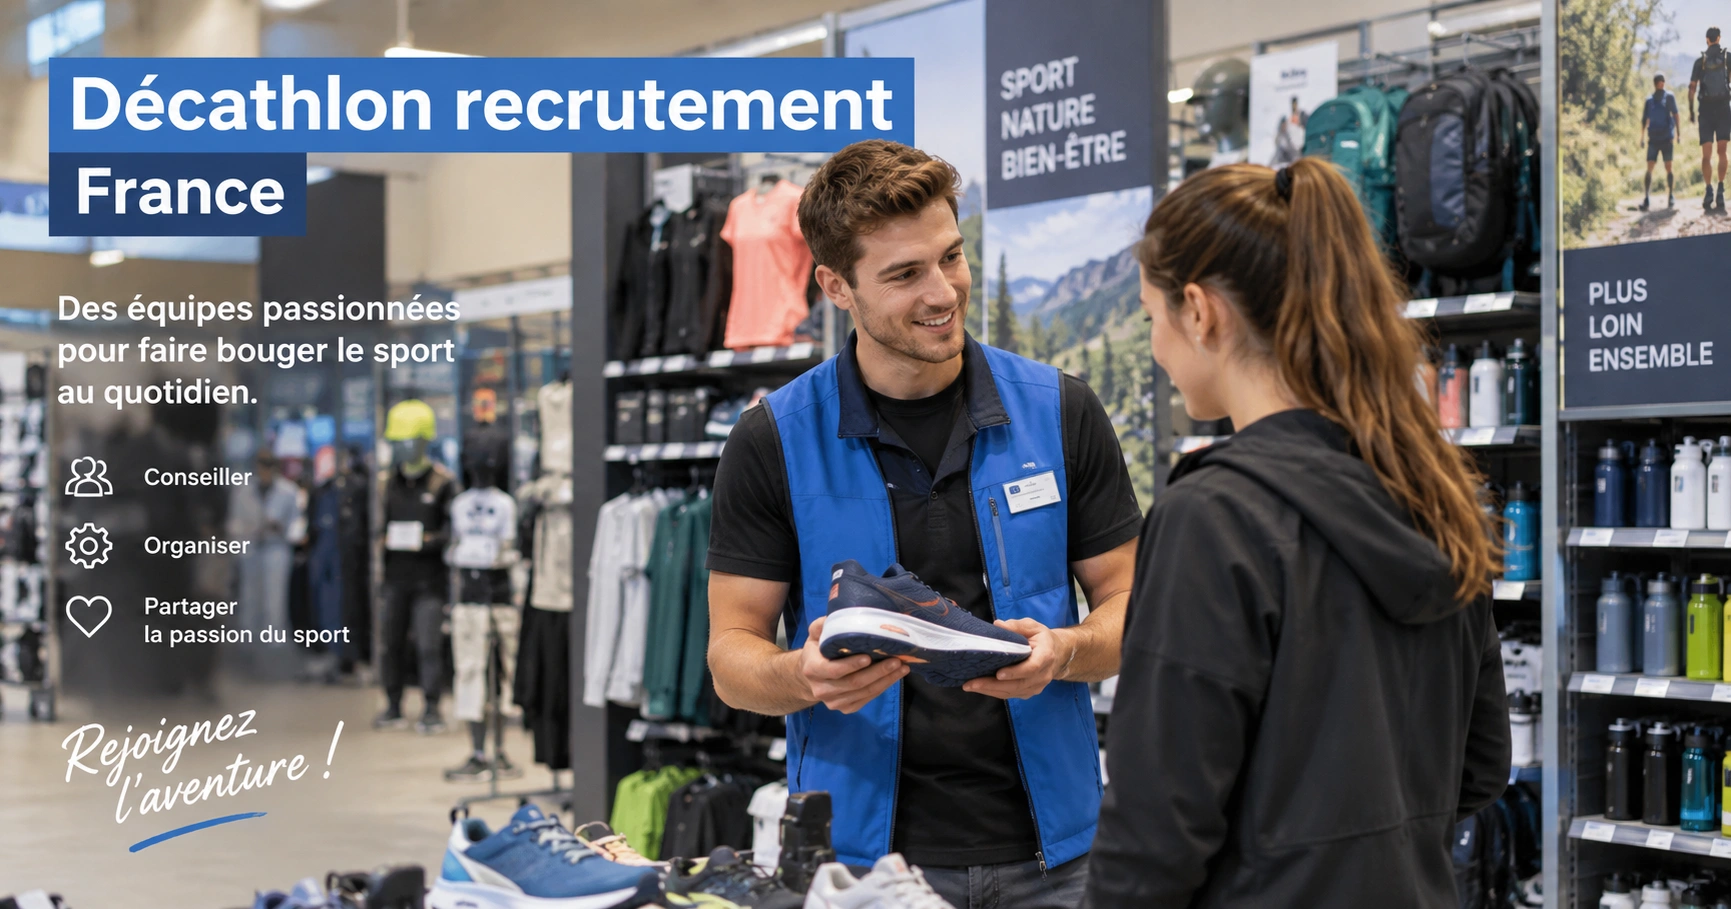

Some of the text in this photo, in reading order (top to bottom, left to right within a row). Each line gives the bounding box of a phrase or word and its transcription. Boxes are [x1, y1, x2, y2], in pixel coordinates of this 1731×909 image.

[1000, 56, 1079, 101] SPORT
[1000, 94, 1096, 141] NATURE
[1001, 130, 1127, 181] BIEN-ÊTRE
[1588, 277, 1648, 306] PLUS
[1588, 311, 1643, 339] LOIN
[1588, 341, 1714, 372] ENSEMBLE
